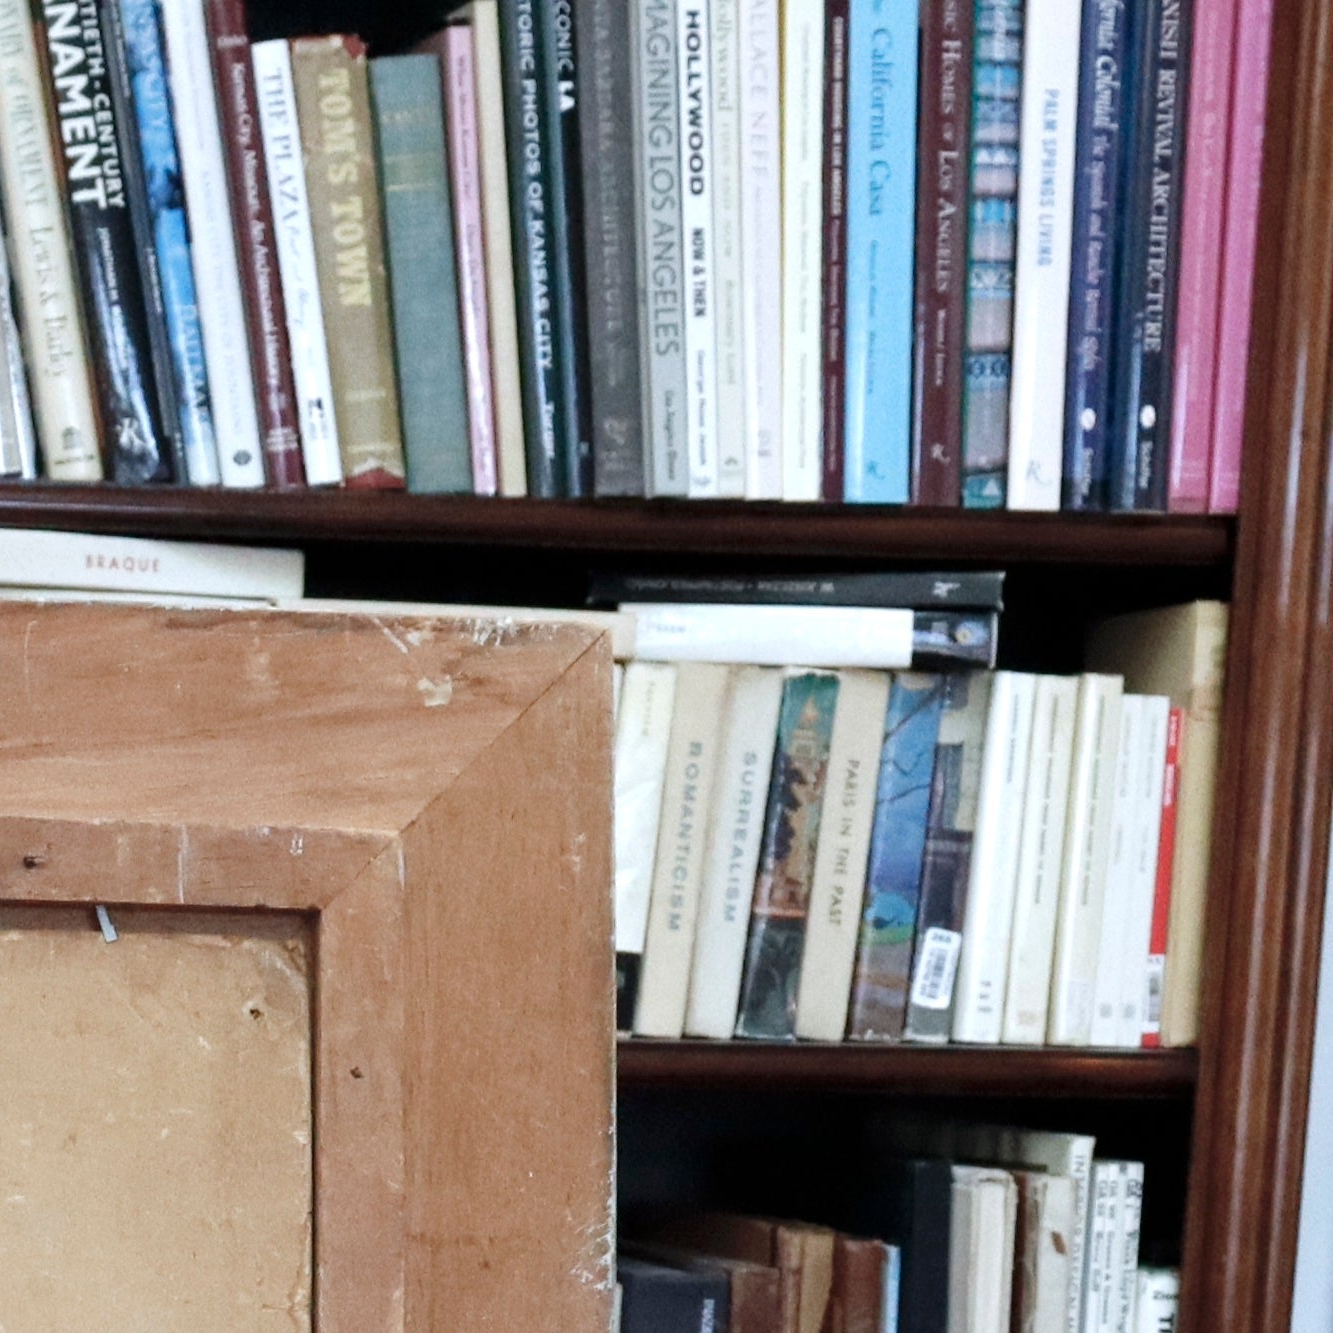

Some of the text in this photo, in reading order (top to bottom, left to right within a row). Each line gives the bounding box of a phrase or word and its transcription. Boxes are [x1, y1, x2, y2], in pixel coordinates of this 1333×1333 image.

[44, 0, 108, 209] NAMENT
[264, 68, 301, 224] THE PLAZA
[521, 79, 542, 174] PHOTOS
[558, 81, 575, 113] LA
[685, 11, 706, 197] HOLLYWOOD
[749, 111, 770, 177] NEFF
[868, 27, 895, 217] California Casa
[934, 39, 963, 294] HOMES LOS ANGELES
[1153, 69, 1177, 161] REVIVAL
[318, 68, 372, 307] TOM'S TOWN
[527, 182, 544, 214] OF
[648, 155, 676, 210] LOS
[691, 228, 706, 261] NOW
[1037, 89, 1061, 266] PALM SPRINGS LIVING
[529, 219, 551, 313] KANSAS
[651, 218, 681, 357] ANGELES
[691, 281, 708, 318] THEN
[1143, 167, 1173, 354] ARCHITECTURE
[534, 318, 553, 370] CITY
[84, 554, 162, 574] BRAQUE
[667, 741, 704, 932] ROMANTICISM
[723, 750, 759, 923] SURREALISM
[828, 760, 861, 927] PARIS IN THE PAST
